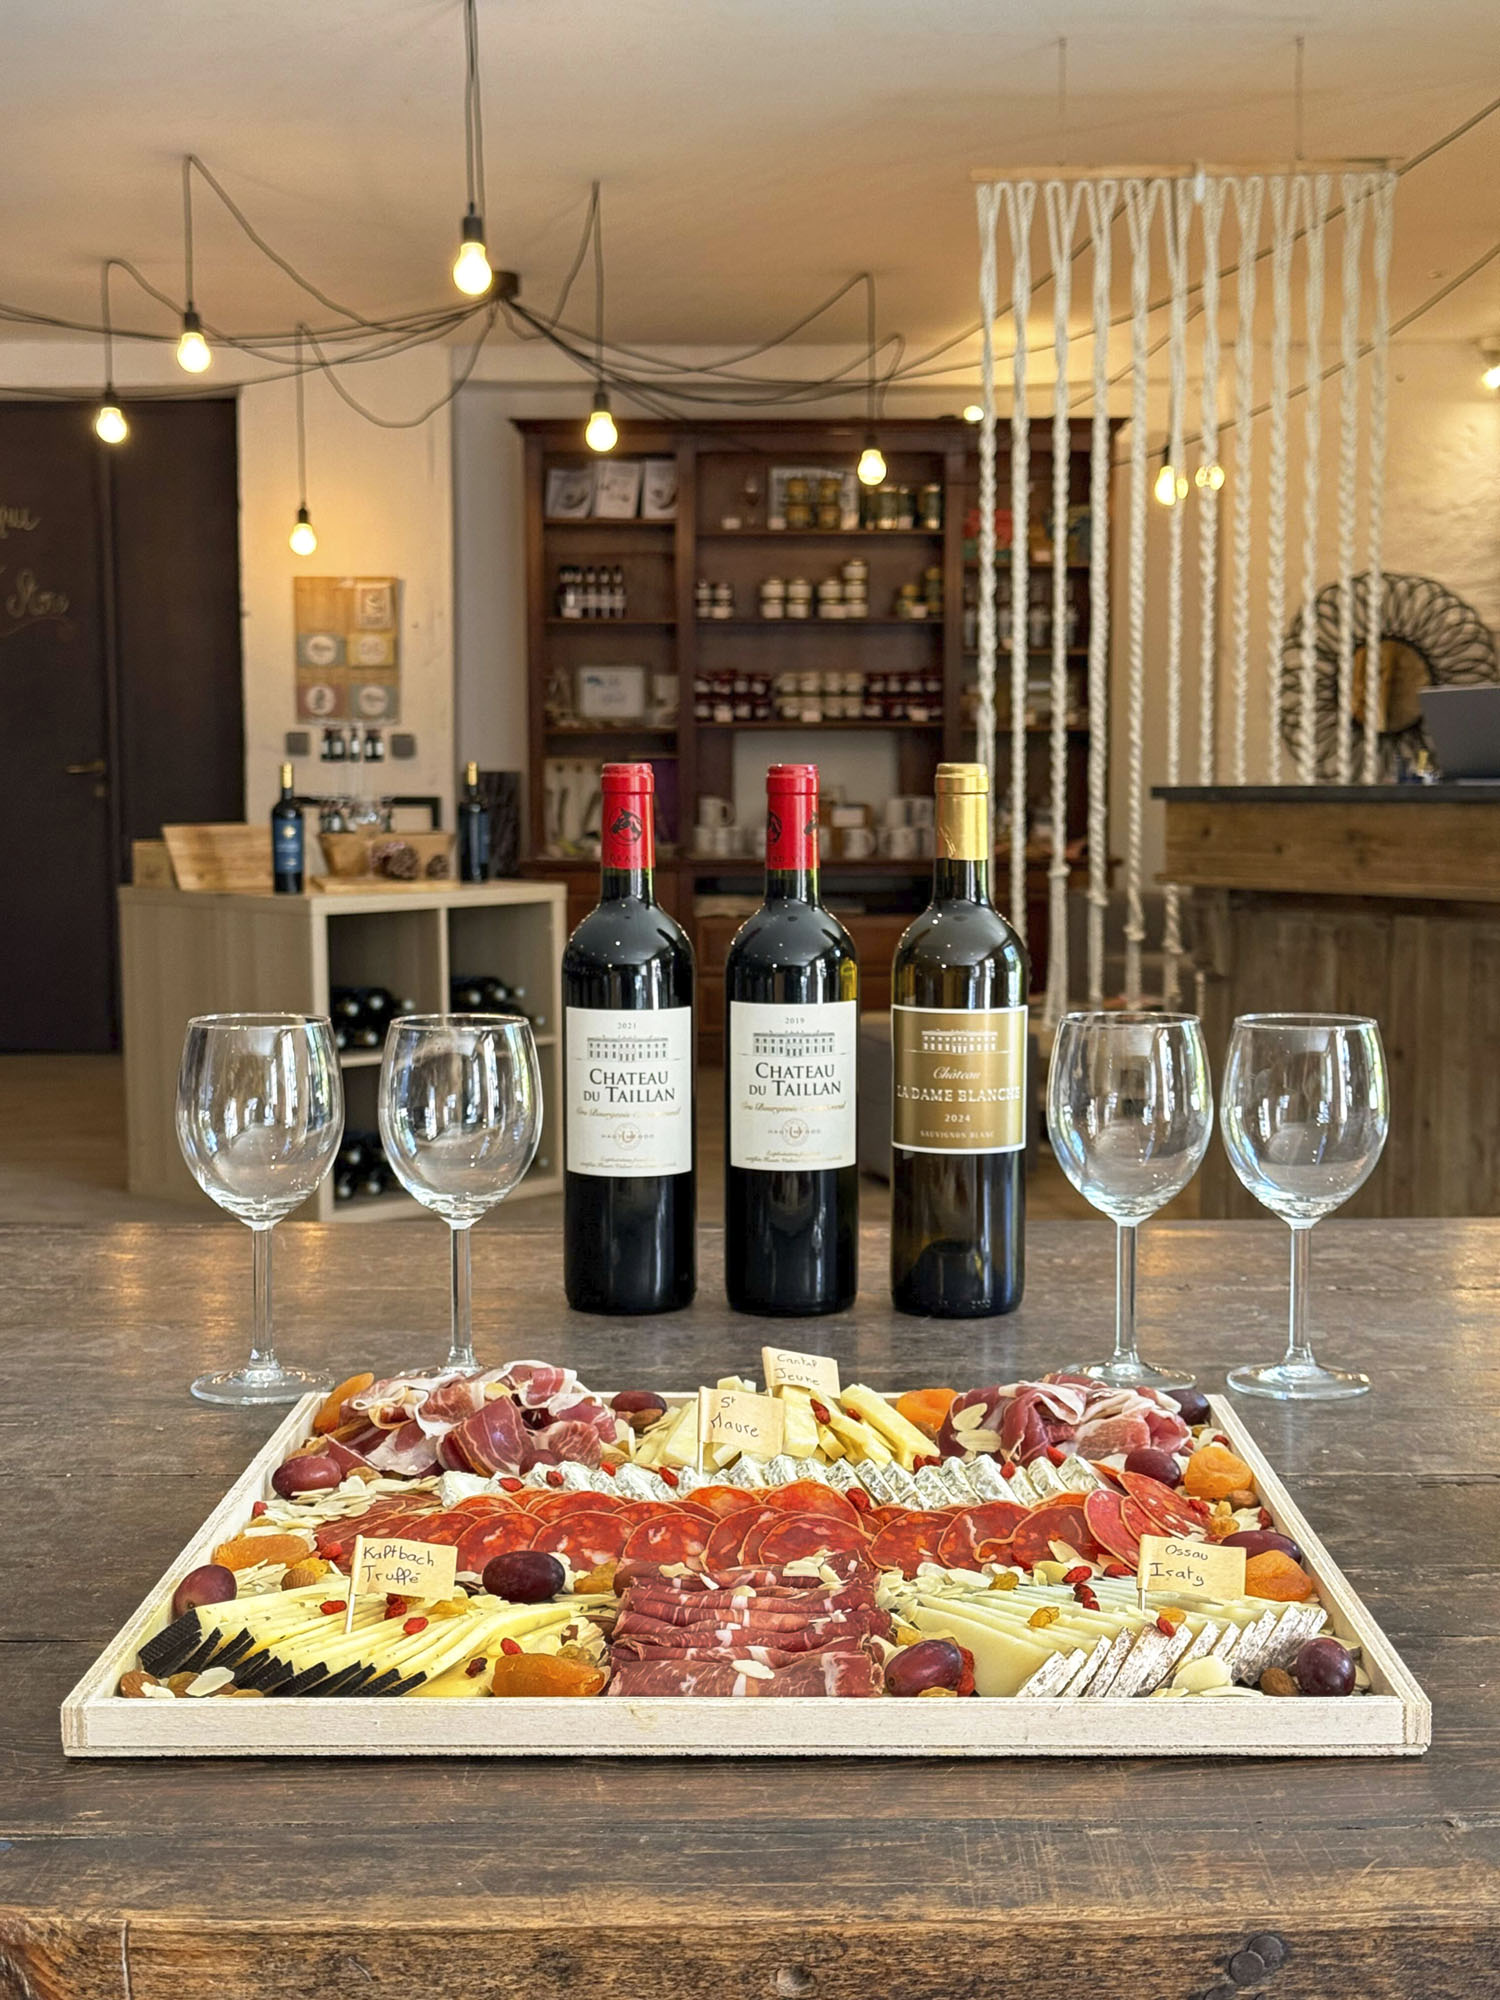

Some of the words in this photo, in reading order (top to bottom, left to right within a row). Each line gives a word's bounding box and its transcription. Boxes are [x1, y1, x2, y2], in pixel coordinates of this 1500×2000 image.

[785, 1017, 806, 1025] 2019
[589, 1068, 669, 1085] CHATEAU
[755, 1062, 835, 1079] CHATEAU
[583, 1090, 600, 1102] DU
[605, 1086, 675, 1103] TAILLAN
[749, 1084, 767, 1096] DU
[771, 1080, 841, 1097] TAILLAN
[897, 1085, 909, 1099] LA
[911, 1087, 953, 1102] DAME
[957, 1085, 1021, 1102] BLANCHE
[944, 1114, 971, 1123] 2024
[1165, 1544, 1209, 1561] Ossau
[1149, 1562, 1205, 1587] Iraty
